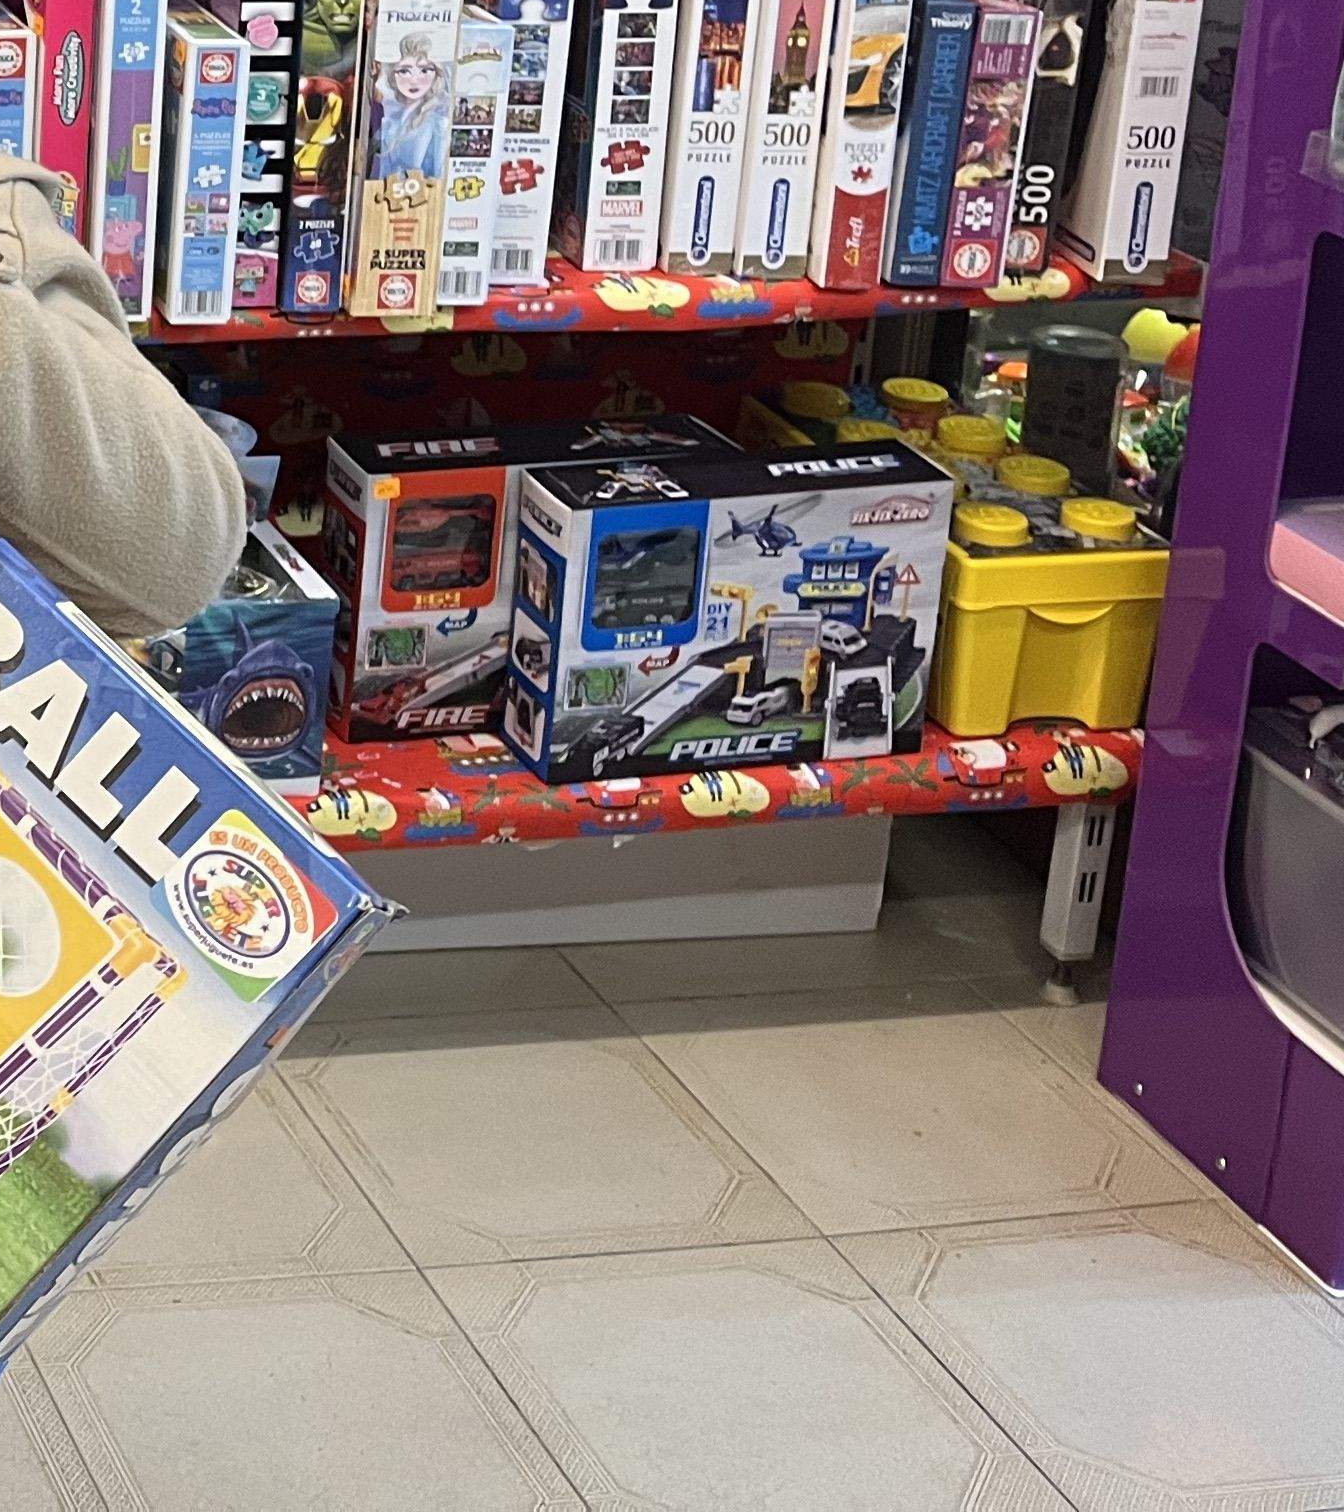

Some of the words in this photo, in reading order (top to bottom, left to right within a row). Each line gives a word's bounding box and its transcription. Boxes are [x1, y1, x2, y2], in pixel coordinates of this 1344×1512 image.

[385, 10, 440, 25] FROZEN
[688, 119, 736, 146] 500
[762, 122, 811, 147] 500
[1126, 124, 1176, 150] 500
[687, 152, 731, 165] PUZZLE
[762, 154, 807, 167] PUZZLE
[1125, 157, 1171, 170] PUZZLE
[1019, 163, 1055, 225] 500
[369, 259, 427, 272] PUZZLES
[384, 249, 427, 261] SUPER
[766, 456, 900, 478] POLICE
[395, 705, 491, 729] FIRE
[669, 730, 804, 762] POLICE
[231, 832, 259, 855] UN
[256, 847, 308, 934] PRODUCTO
